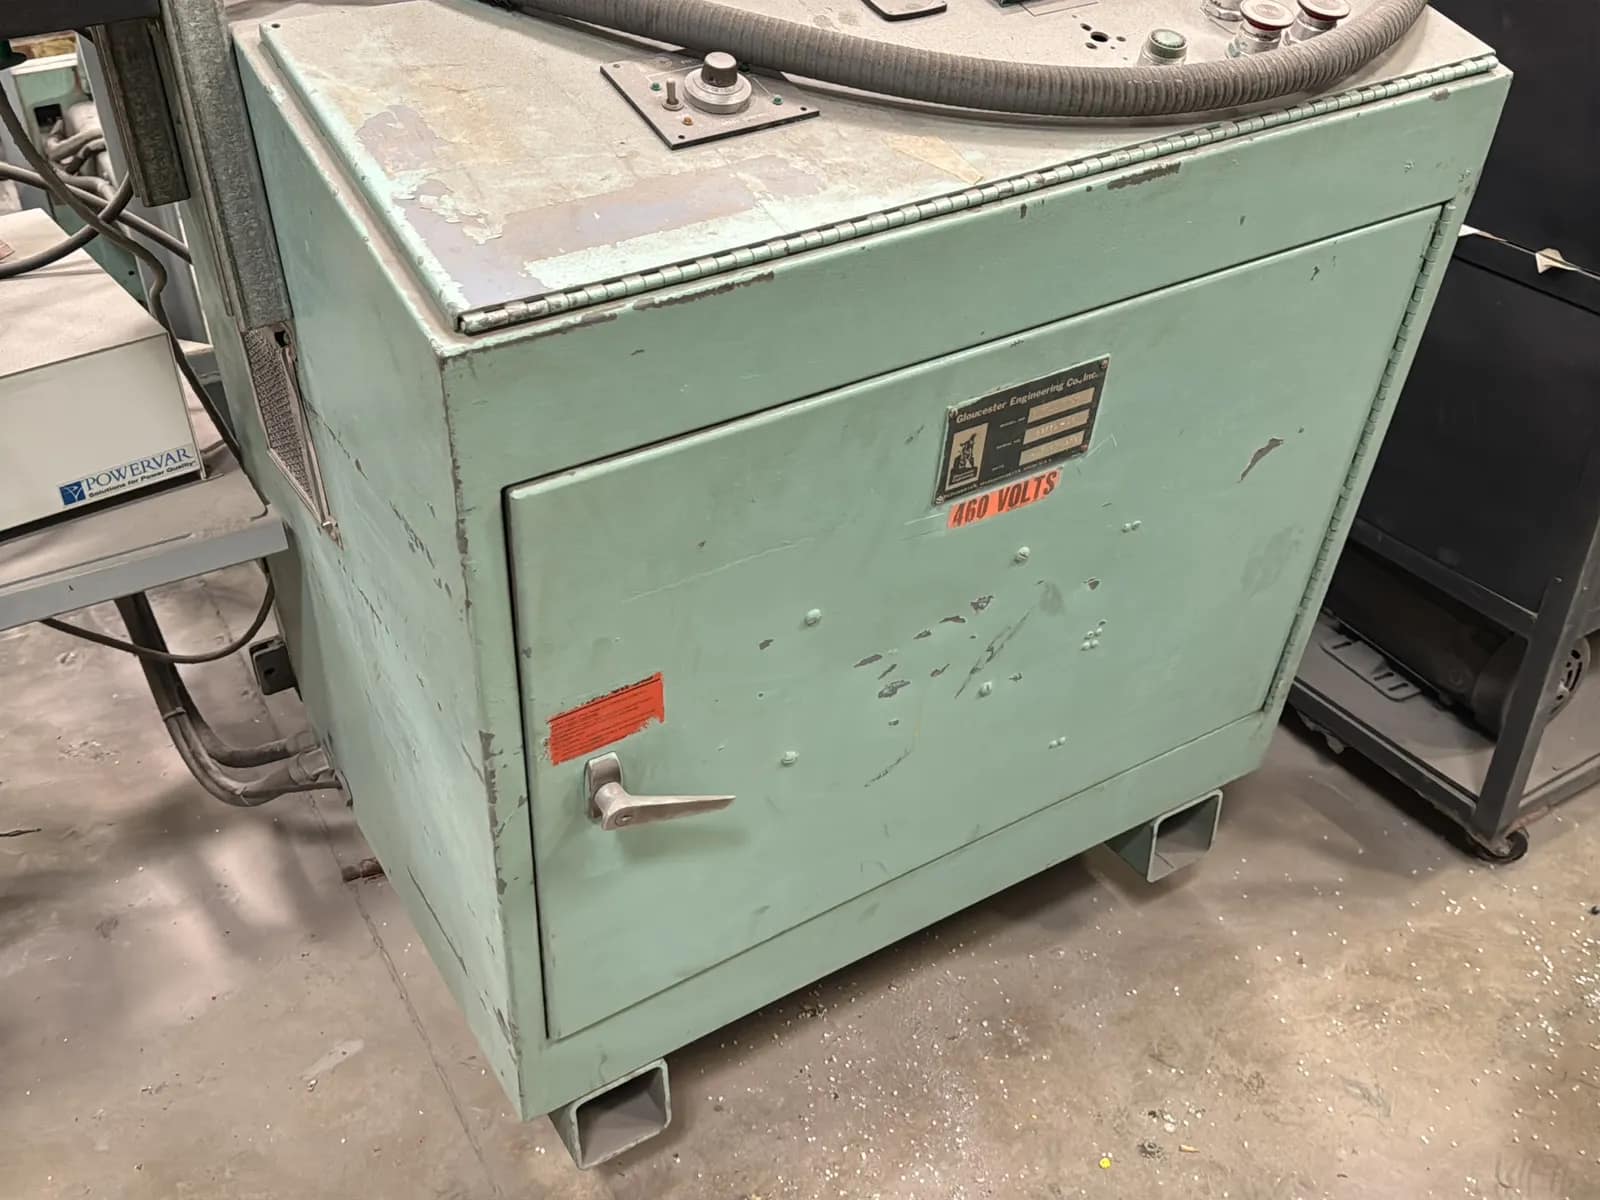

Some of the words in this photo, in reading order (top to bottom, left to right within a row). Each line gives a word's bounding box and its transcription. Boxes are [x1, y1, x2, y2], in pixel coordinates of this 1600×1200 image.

[956, 401, 1007, 424] Gloucester
[1009, 382, 1065, 406] Engineering
[84, 448, 193, 491] POWERVAR
[88, 482, 126, 498] Solutions
[127, 478, 139, 486] for
[140, 470, 165, 482] Power
[952, 494, 989, 527] 460
[997, 471, 1058, 513] VOLTS
